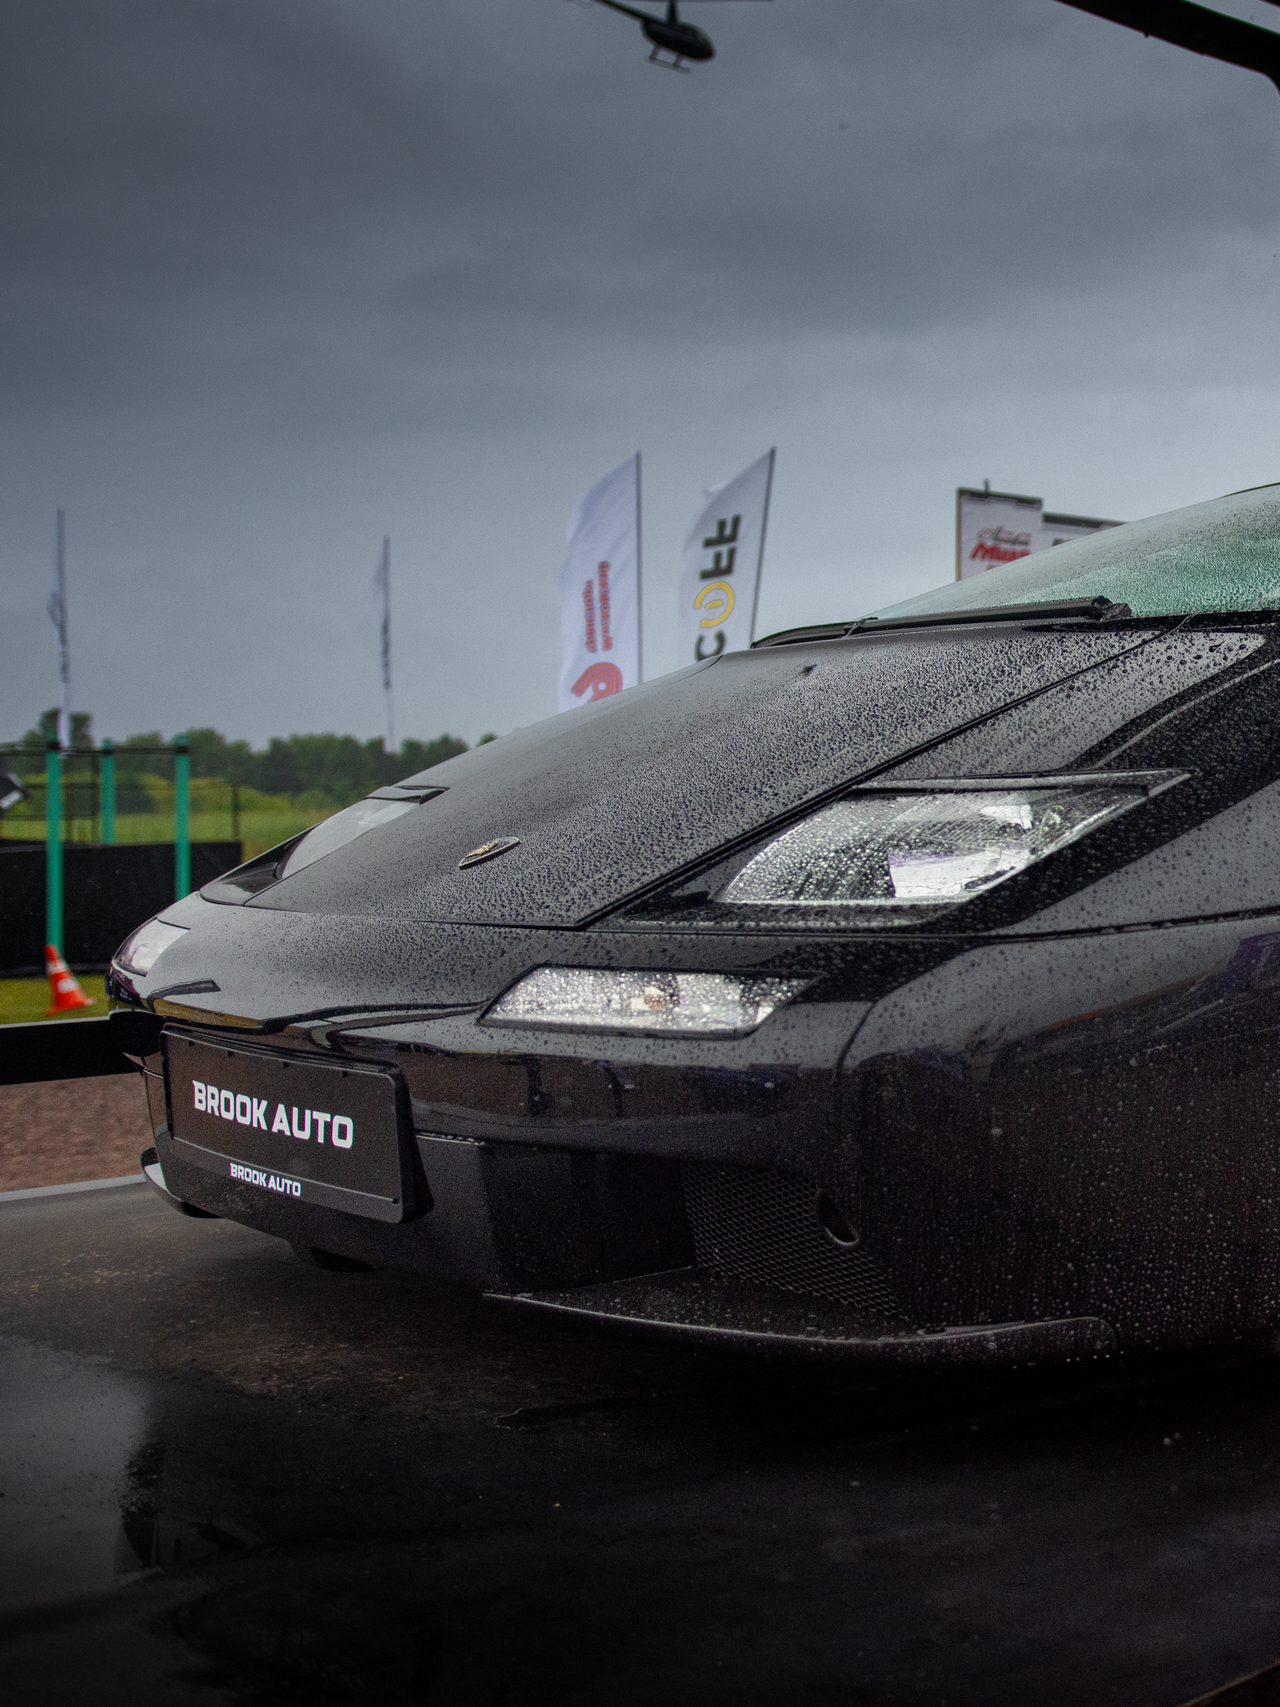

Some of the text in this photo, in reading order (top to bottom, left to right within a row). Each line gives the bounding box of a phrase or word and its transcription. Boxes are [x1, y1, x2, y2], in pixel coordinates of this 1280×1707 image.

[192, 1080, 353, 1149] BROOK AUTO
[230, 1162, 301, 1197] BROOK AUTO
